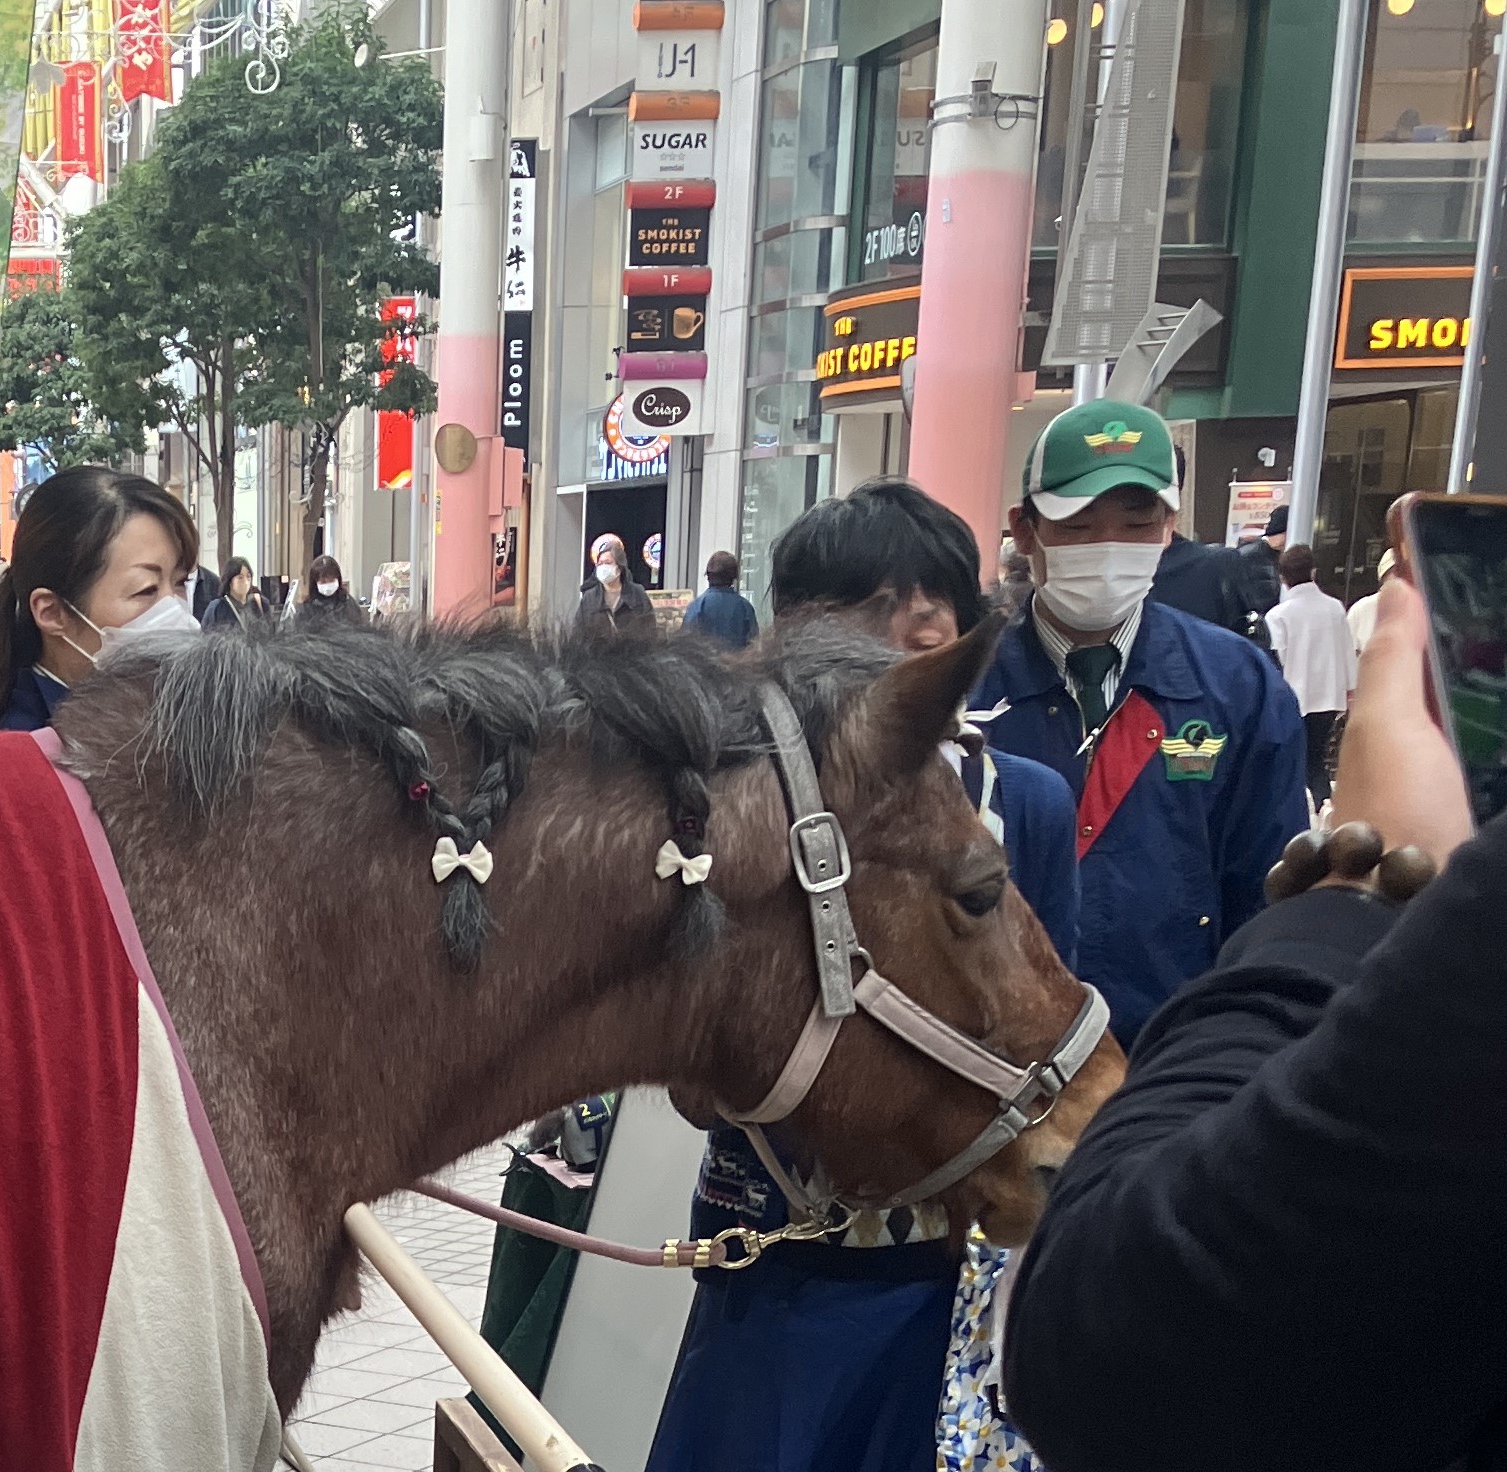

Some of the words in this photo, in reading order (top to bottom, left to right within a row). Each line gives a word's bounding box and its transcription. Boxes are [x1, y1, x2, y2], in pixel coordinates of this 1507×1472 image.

[640, 133, 708, 150] SUGAR
[659, 164, 685, 172] sendai
[664, 186, 684, 200] 2F
[638, 229, 702, 241] SMOKIST
[642, 243, 696, 254] COFFEE
[663, 274, 679, 287] 1F
[503, 339, 524, 426] Ploom
[641, 394, 682, 424] Crisp
[579, 1103, 591, 1117] 2
